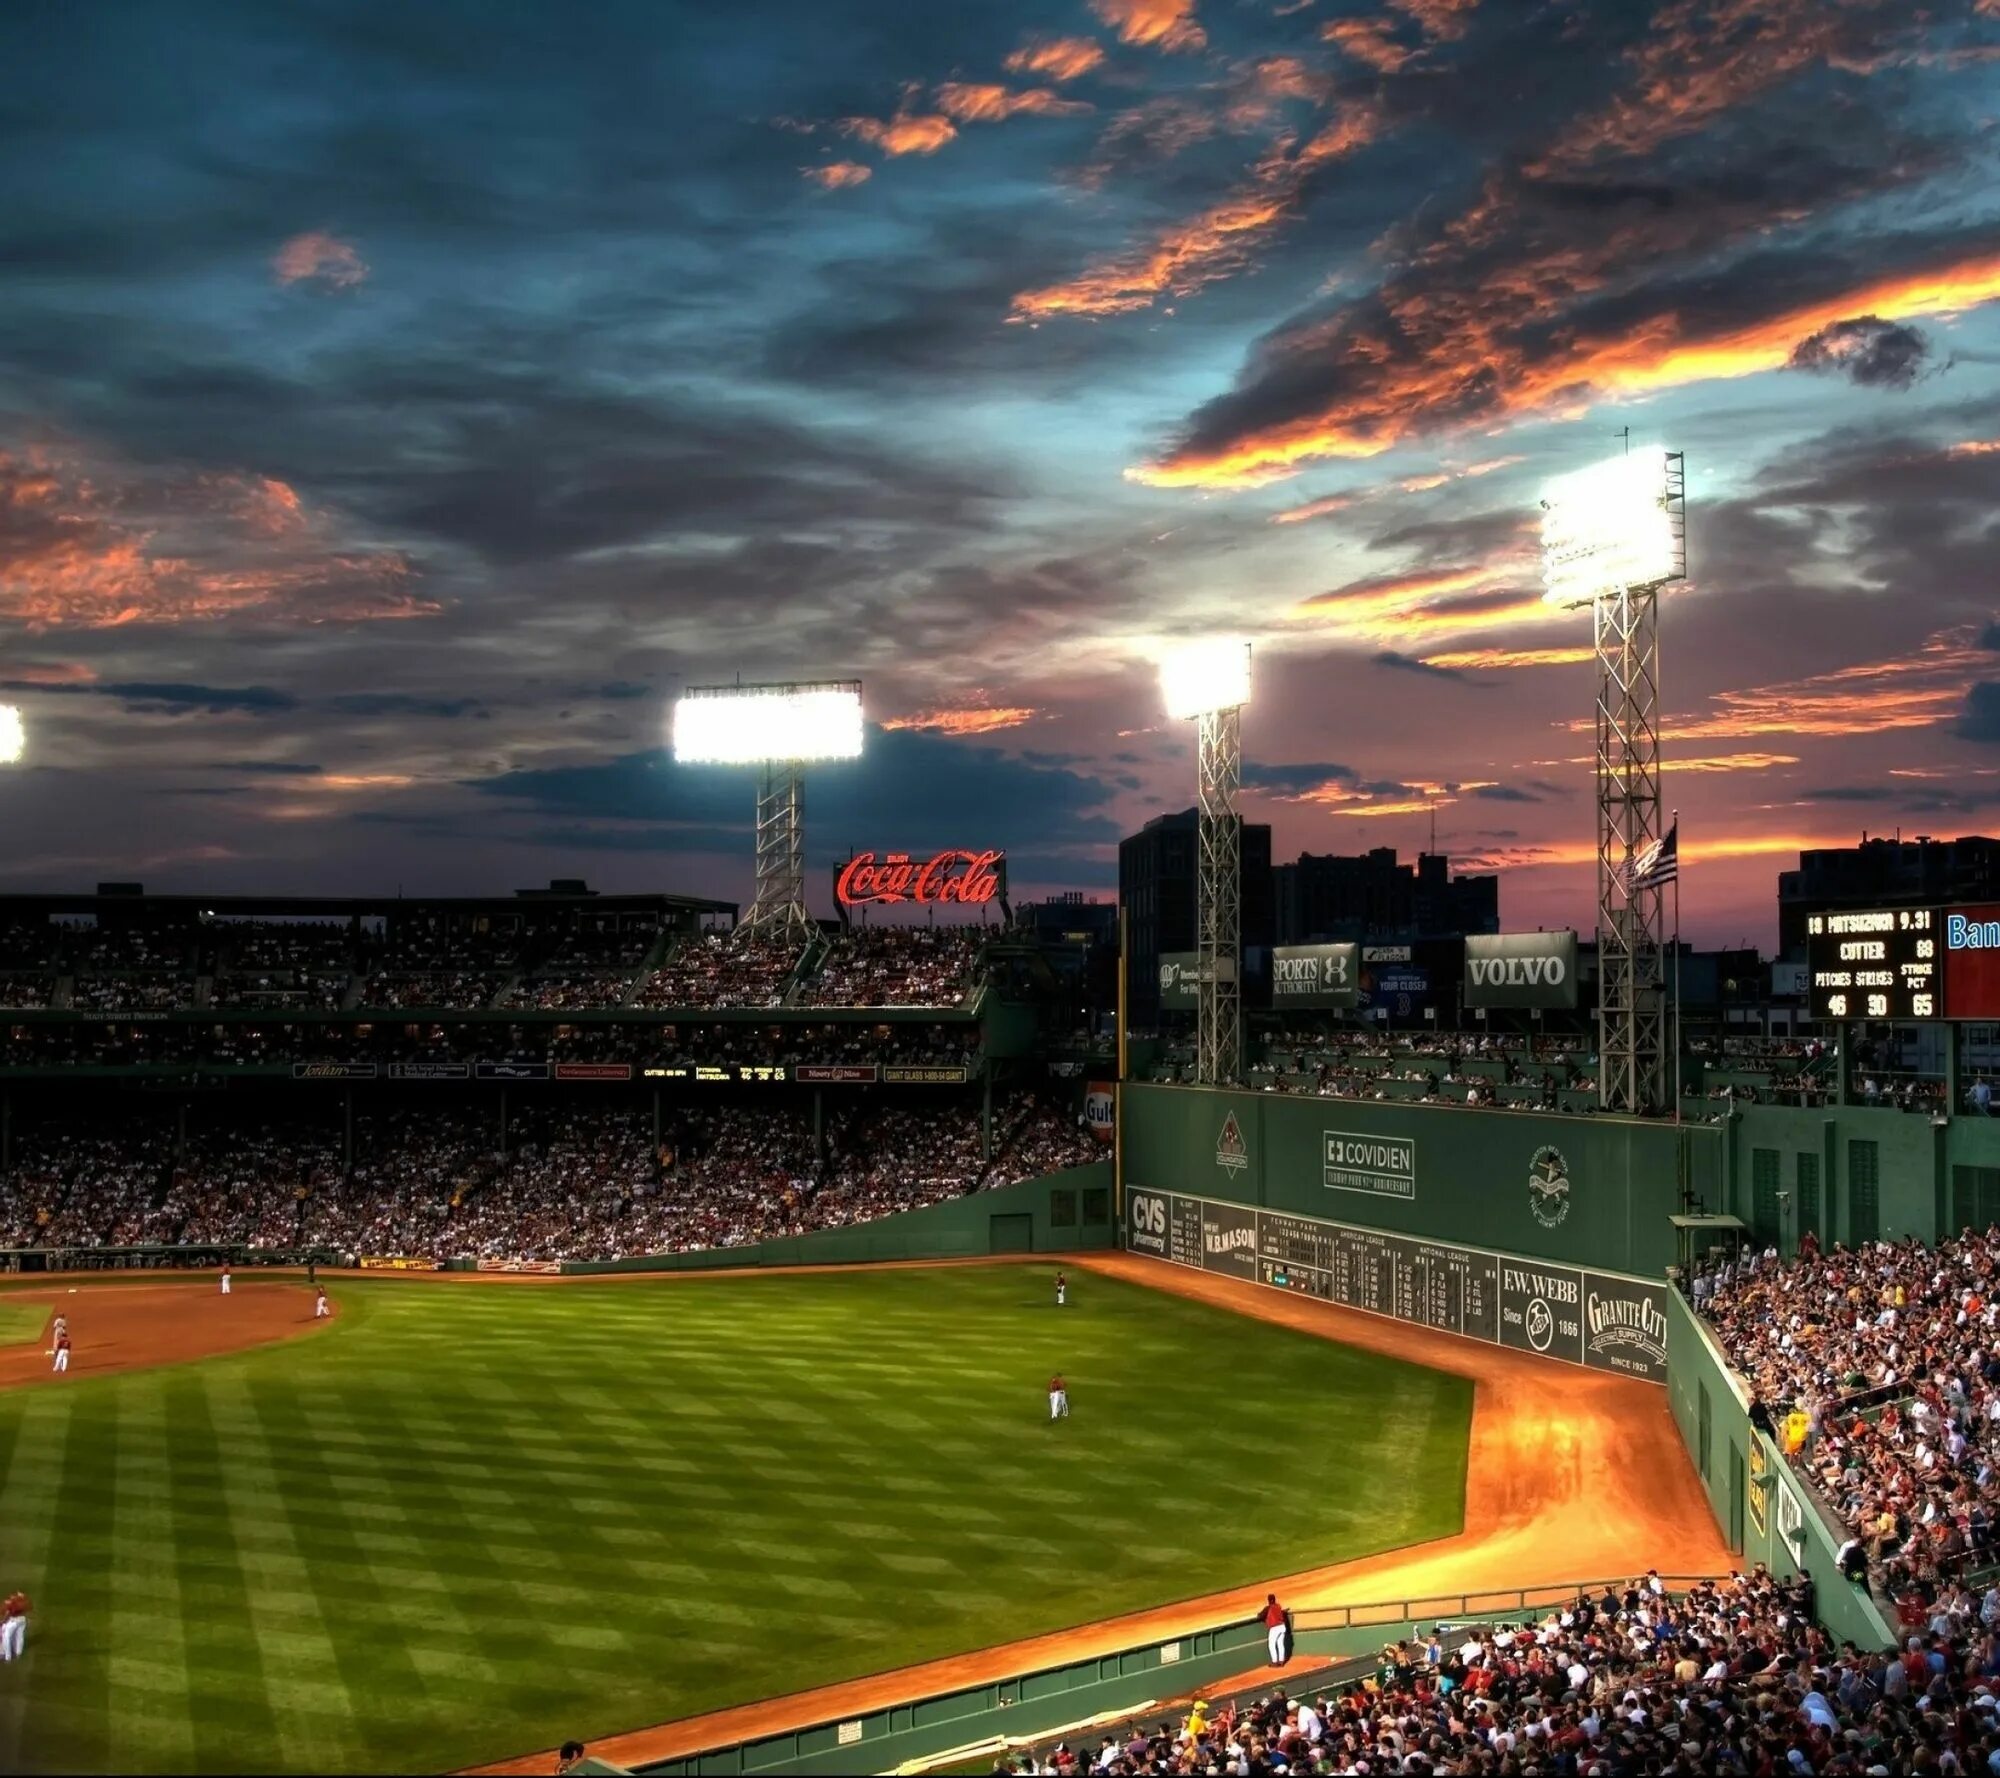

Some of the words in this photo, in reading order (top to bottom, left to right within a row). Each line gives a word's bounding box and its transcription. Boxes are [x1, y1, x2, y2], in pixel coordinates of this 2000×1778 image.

[1900, 911, 1930, 930] 9.31
[1840, 942, 1885, 960] CUTTER
[1273, 957, 1318, 981] SPORTS
[1467, 956, 1566, 986] VOLVO
[1901, 964, 1932, 975] STRIKE
[1379, 981, 1399, 991] YOUR
[1400, 981, 1428, 991] CLOSER
[1815, 972, 1851, 987] PITCHES
[1856, 971, 1893, 986] STRIKES
[1907, 978, 1926, 988] PCT
[1828, 995, 1846, 1015] 46
[1868, 994, 1886, 1015] 30
[1913, 994, 1932, 1015] 65
[887, 1071, 904, 1080] GIANT
[904, 1071, 924, 1080] GLASS
[946, 1071, 962, 1081] GIANT
[1346, 1143, 1410, 1171] COVIDIEN
[1373, 1178, 1410, 1194] ANNIVERSARY
[1132, 1195, 1165, 1234] CVS
[1271, 1217, 1296, 1227] FENWAY
[1300, 1223, 1318, 1232] PARK
[1132, 1230, 1166, 1253] pharmacy
[1340, 1231, 1365, 1242] AMERICAN
[1366, 1236, 1385, 1247] LEAGUE
[1420, 1247, 1446, 1258] NATIONAL
[1447, 1252, 1469, 1263] LEAGUE
[1531, 1274, 1578, 1304] WEBB
[1503, 1307, 1522, 1325] Since
[1558, 1319, 1578, 1337] 1866
[1588, 1291, 1641, 1335] GRANITE
[1594, 1332, 1617, 1347] ELECTRIC
[1617, 1329, 1643, 1342] SUPPLY
[1610, 1356, 1630, 1368] SINCE
[1632, 1361, 1648, 1373] 1923
